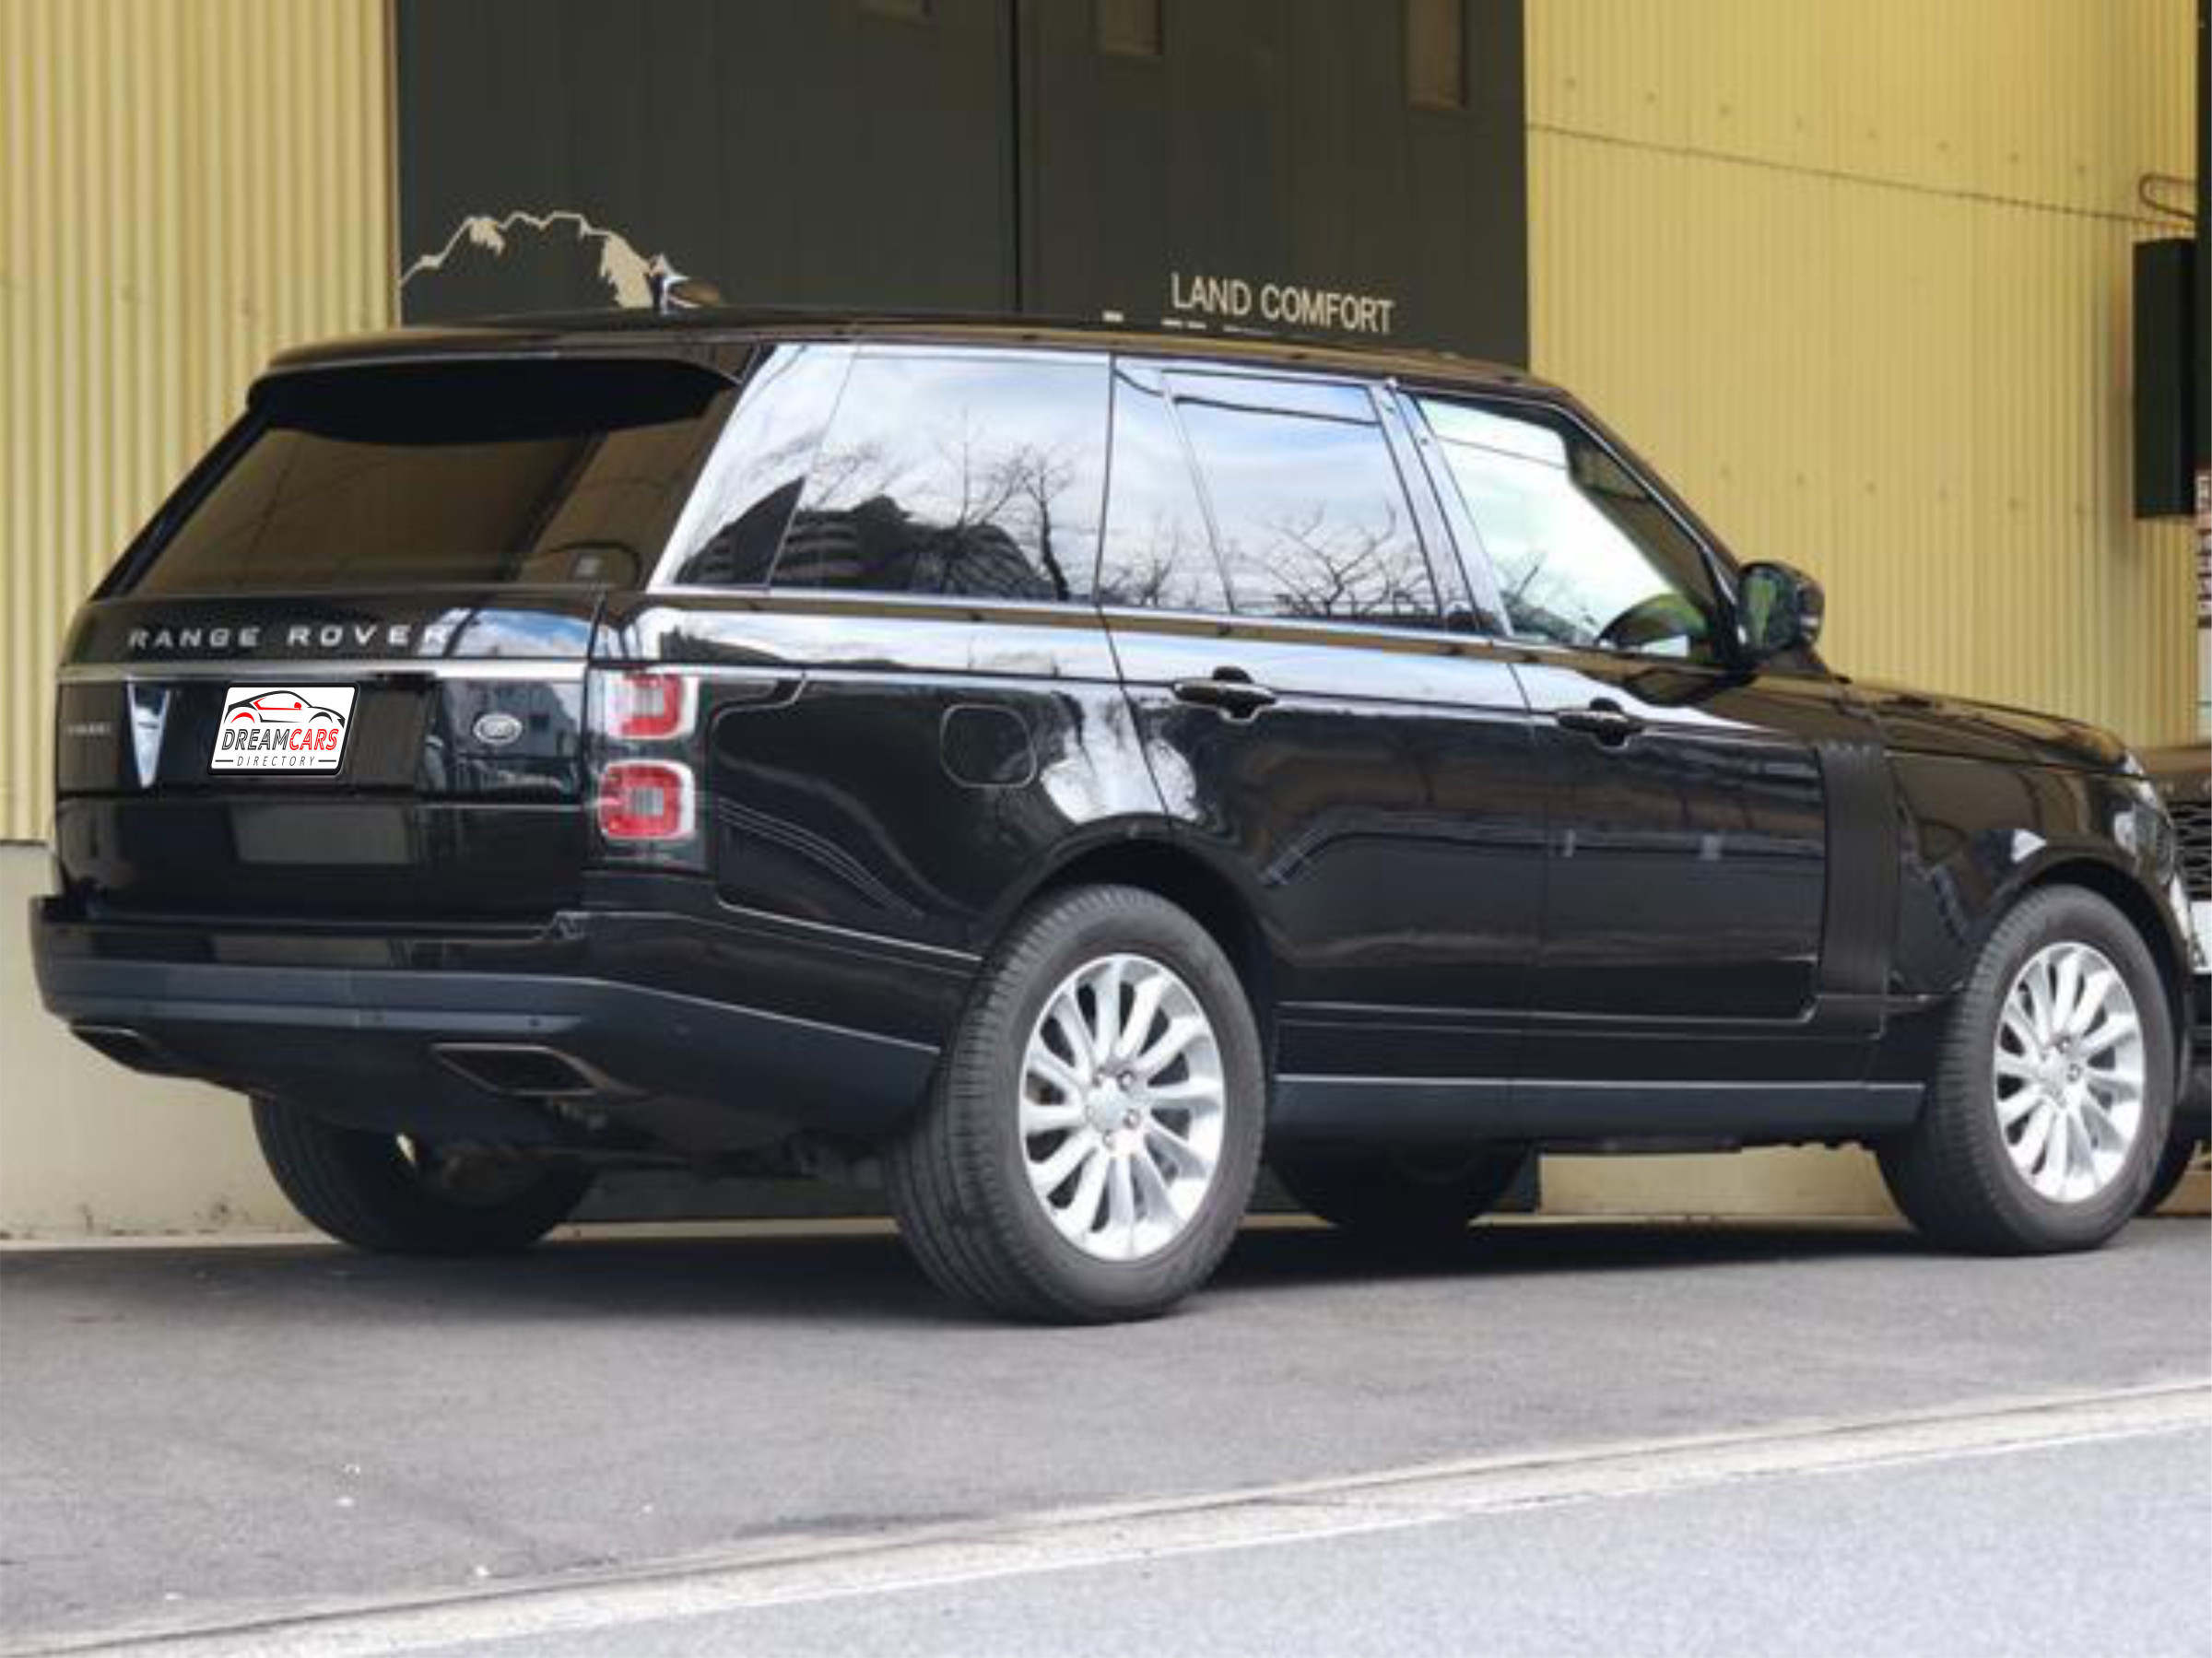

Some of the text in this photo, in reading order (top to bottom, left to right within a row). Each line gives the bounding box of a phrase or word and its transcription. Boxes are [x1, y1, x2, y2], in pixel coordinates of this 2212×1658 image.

[1171, 272, 1395, 334] LAND COMFORT
[127, 624, 452, 650] RANGE ROVER
